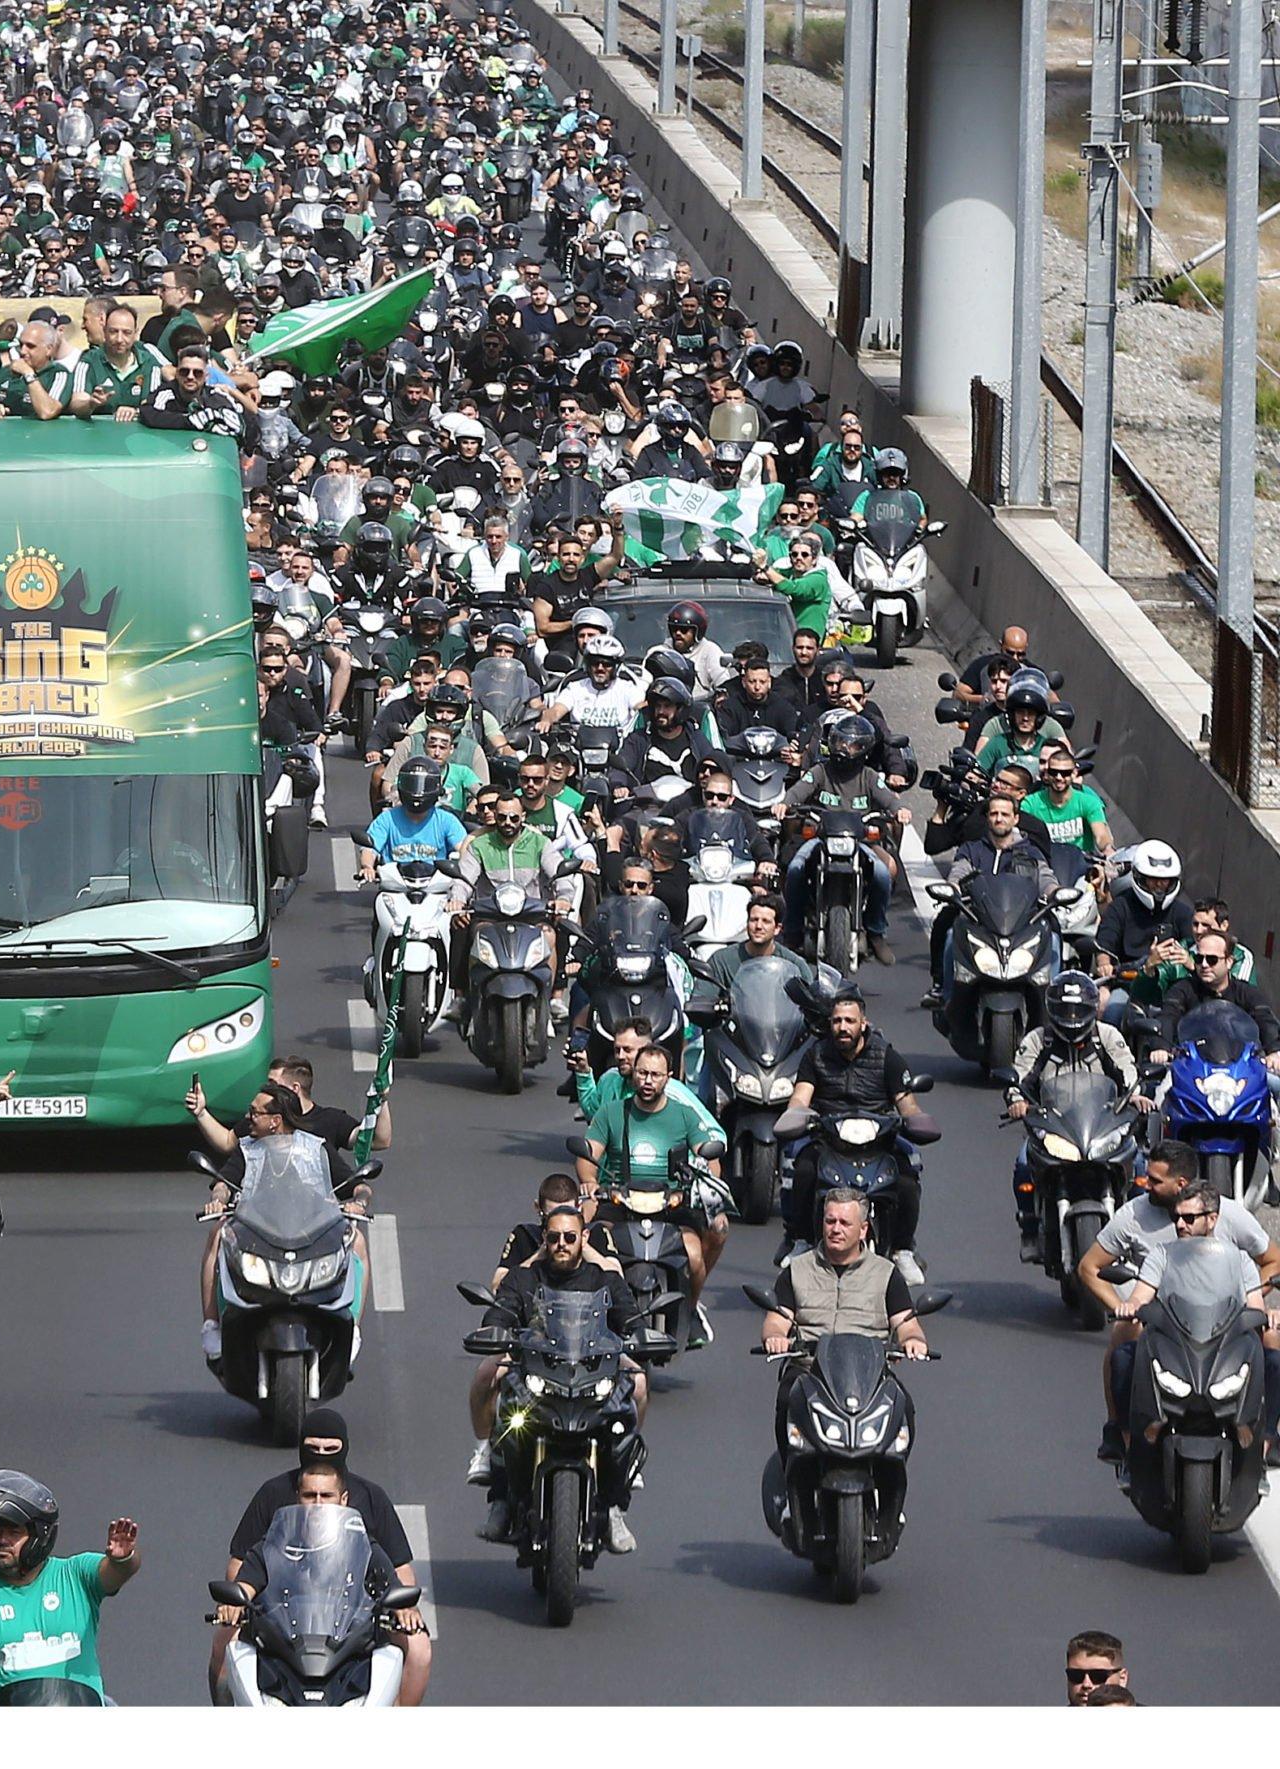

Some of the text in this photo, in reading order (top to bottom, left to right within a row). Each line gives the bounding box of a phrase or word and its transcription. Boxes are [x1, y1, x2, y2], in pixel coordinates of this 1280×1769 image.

[11, 621, 52, 639] THE
[38, 721, 136, 745] CHAMPIONS
[41, 740, 86, 757] 2024
